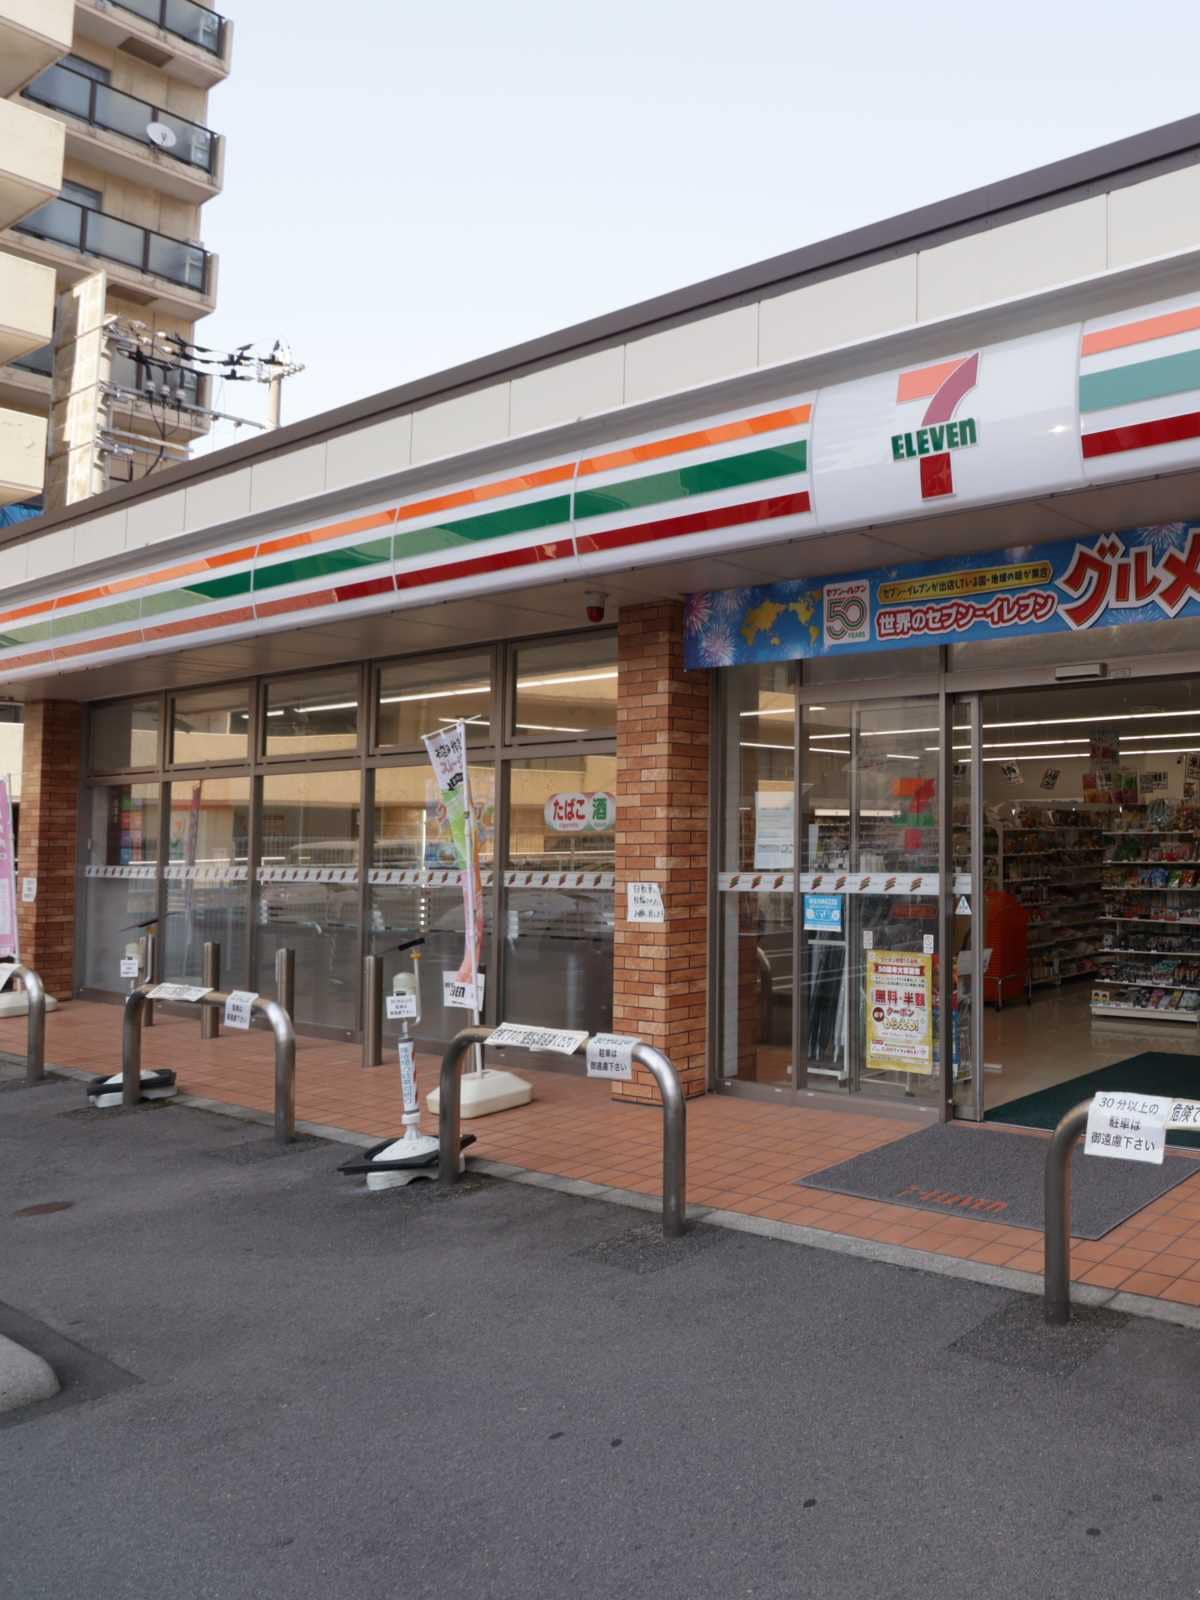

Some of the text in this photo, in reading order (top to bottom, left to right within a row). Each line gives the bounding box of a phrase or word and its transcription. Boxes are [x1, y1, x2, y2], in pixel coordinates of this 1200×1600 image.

[896, 352, 979, 498] 7
[826, 597, 867, 640] 50
[553, 797, 607, 821] たばこ 酒
[1099, 1097, 1160, 1115] 30分以上の
[1109, 1116, 1142, 1131] 駐車は
[1091, 1132, 1155, 1152] 御遠慮下さい
